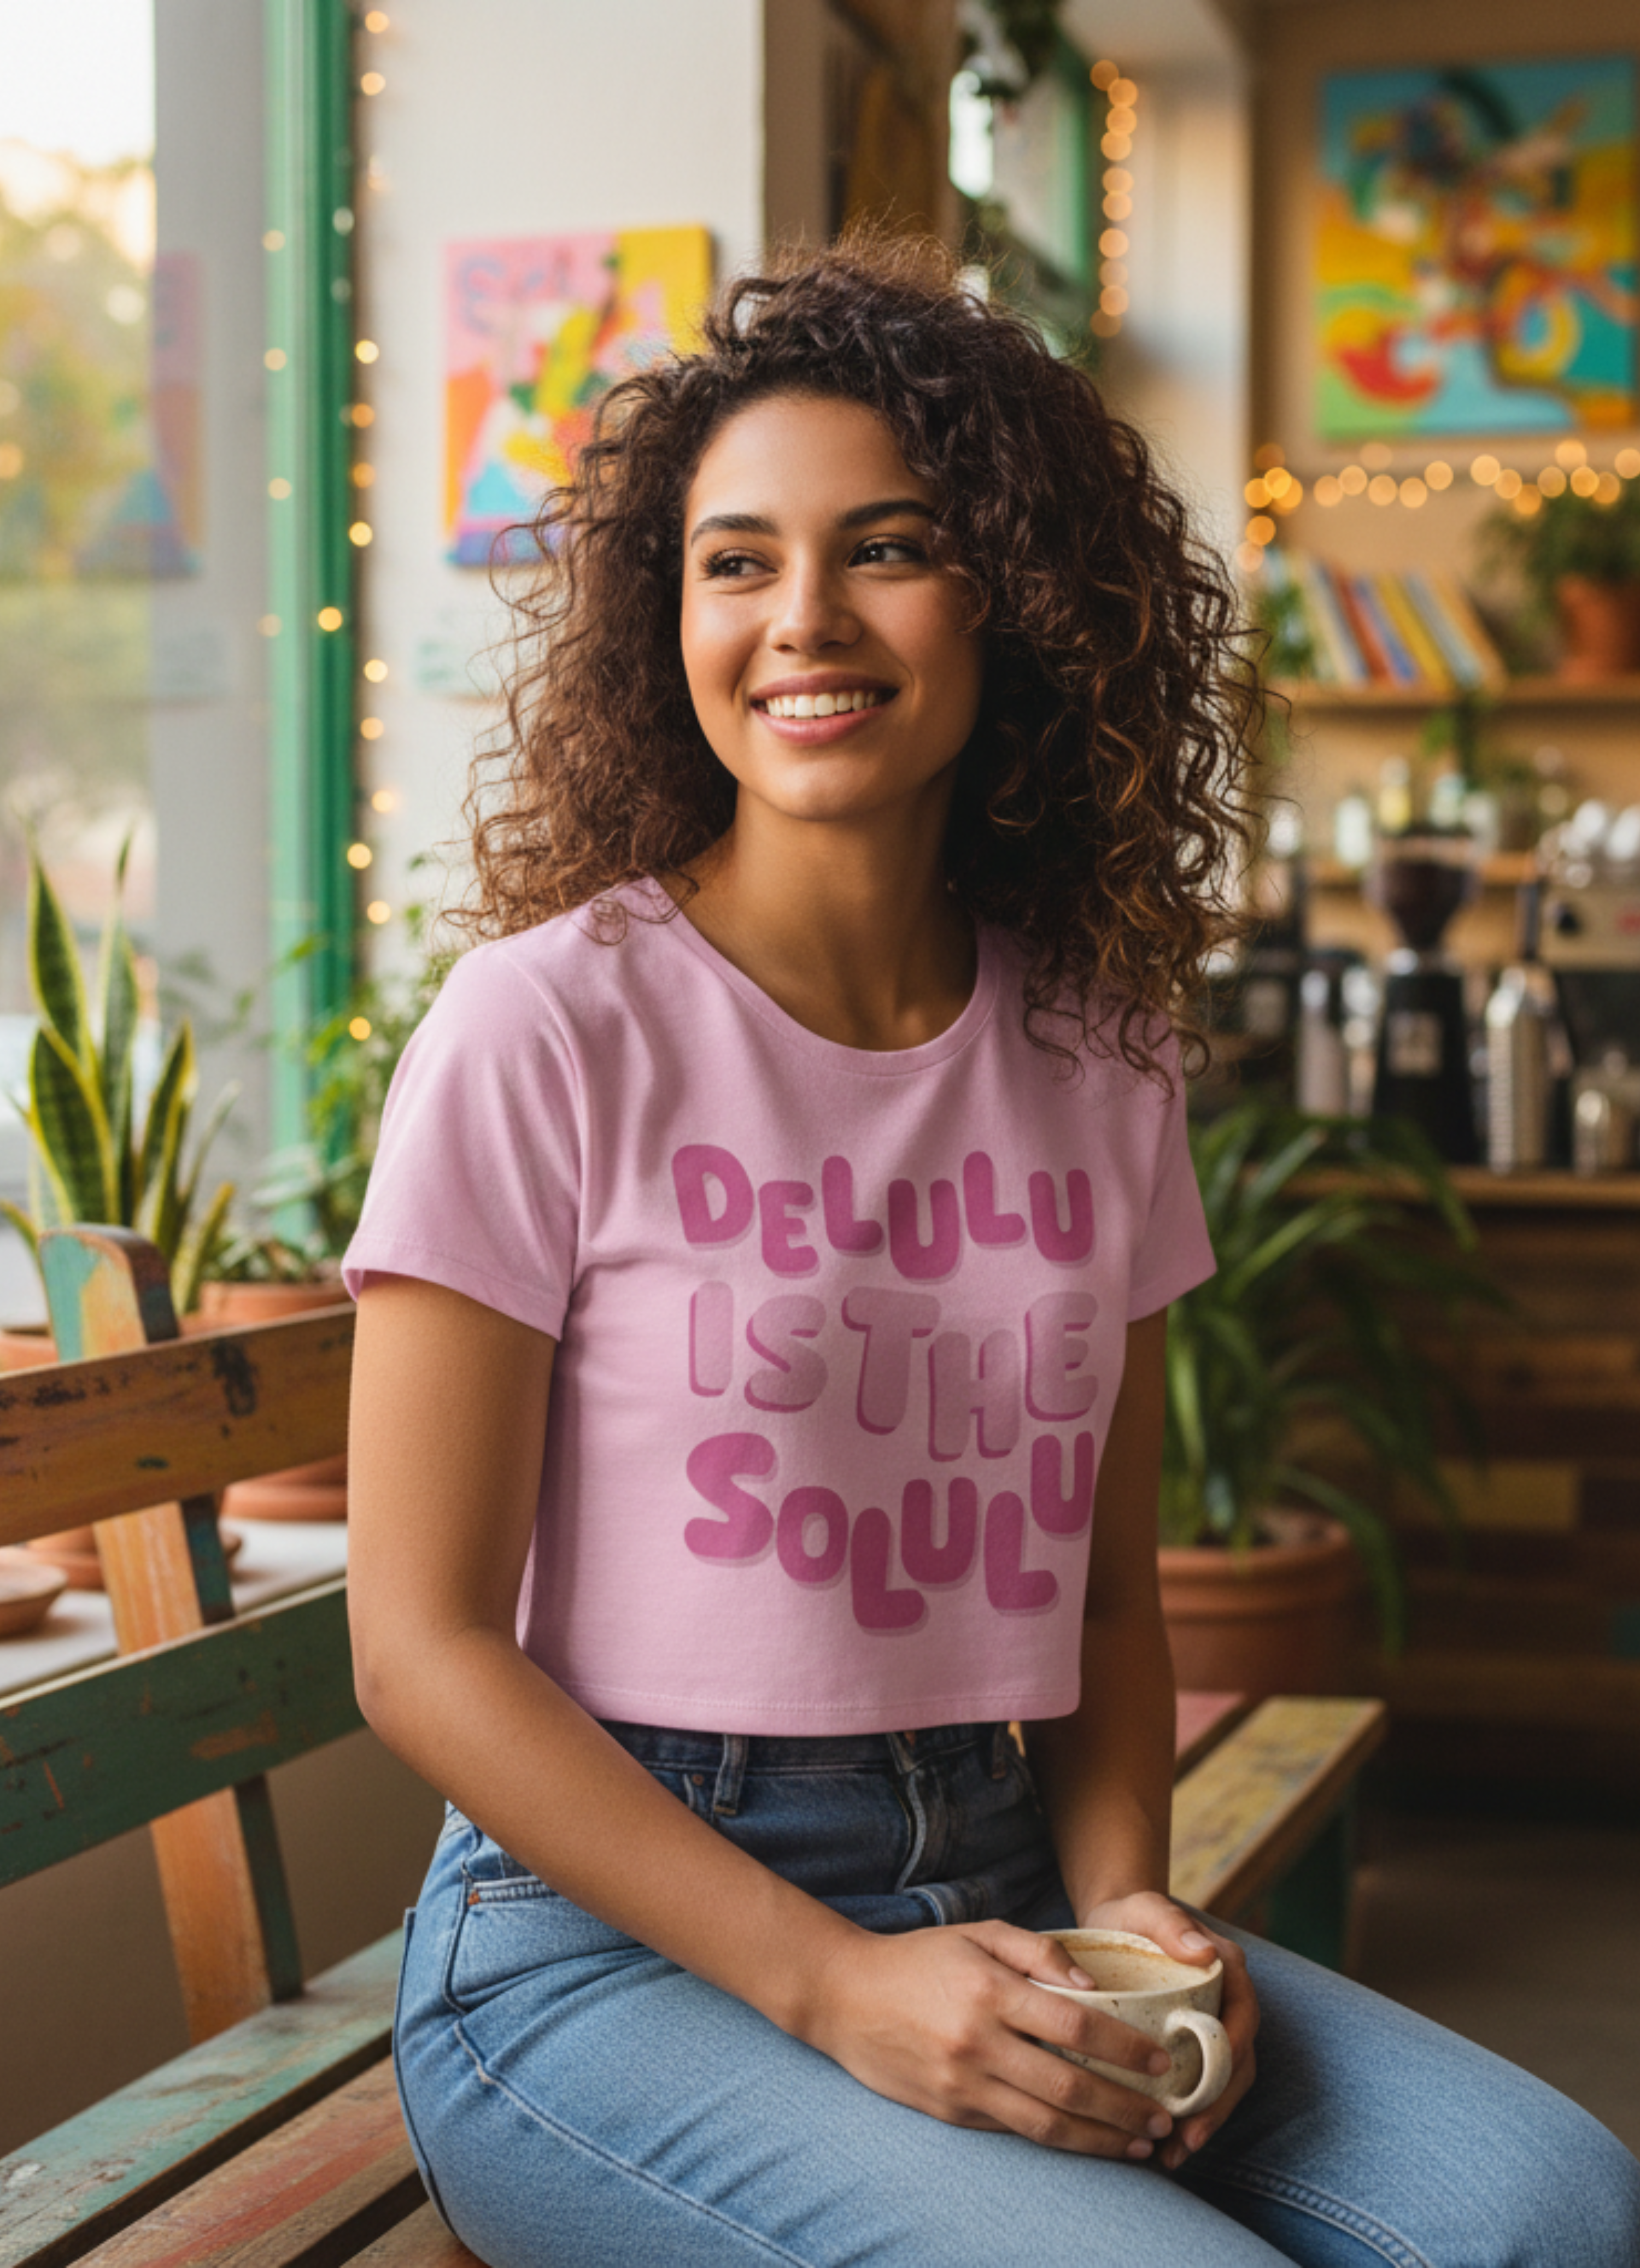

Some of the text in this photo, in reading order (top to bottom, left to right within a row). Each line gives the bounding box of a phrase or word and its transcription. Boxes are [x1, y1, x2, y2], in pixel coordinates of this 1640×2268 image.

[671, 1143, 1094, 1282] DELULU
[688, 1280, 1098, 1462] IS THE
[683, 1431, 1094, 1635] SOLULU
